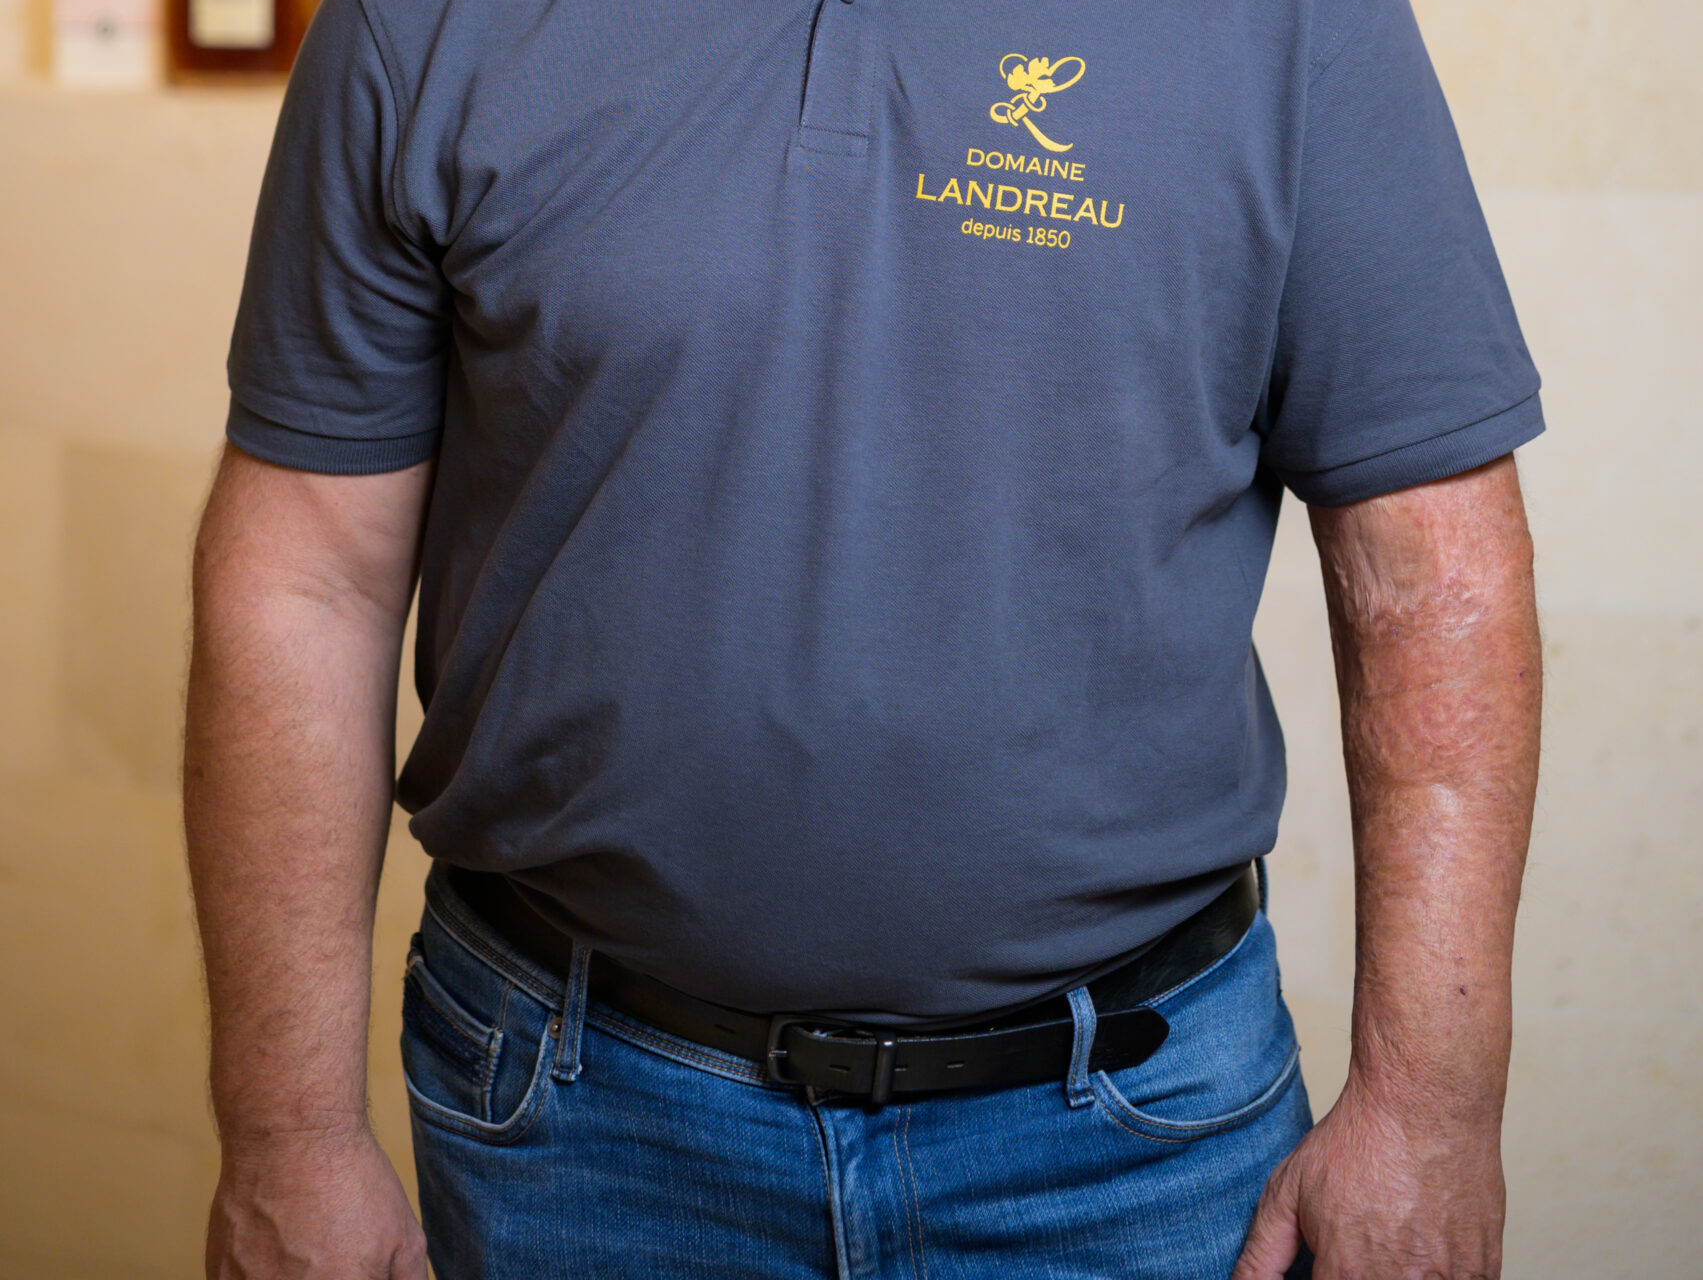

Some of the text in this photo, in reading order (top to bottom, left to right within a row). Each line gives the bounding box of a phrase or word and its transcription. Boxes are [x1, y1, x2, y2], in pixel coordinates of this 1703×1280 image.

[966, 148, 1086, 182] DOMAINE
[915, 173, 1125, 229] LANDREAU
[961, 218, 1071, 249] depuis 1850
